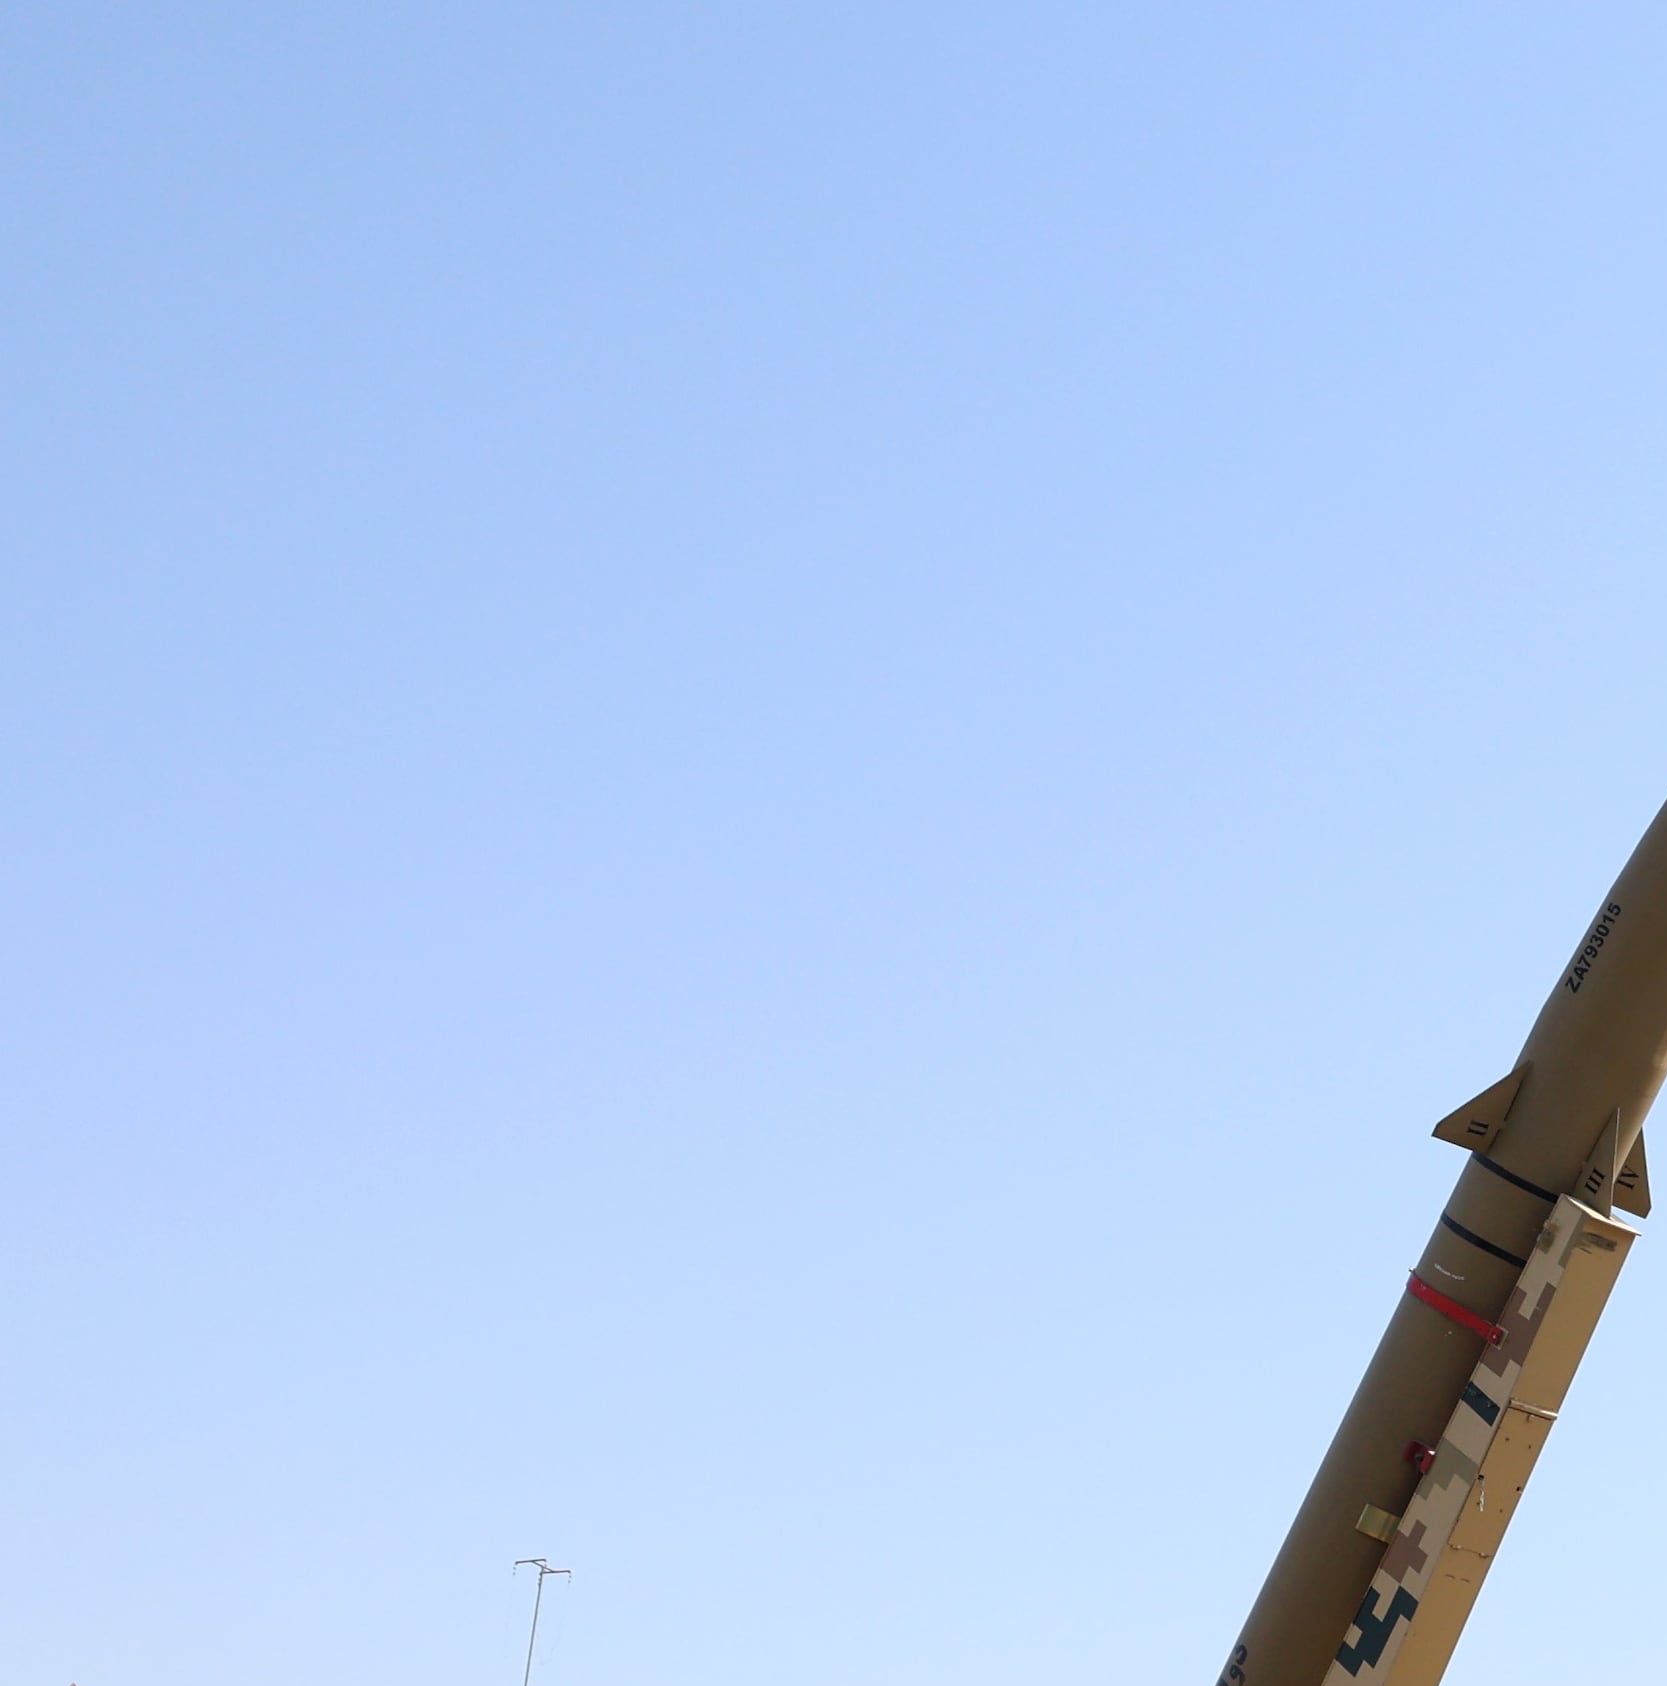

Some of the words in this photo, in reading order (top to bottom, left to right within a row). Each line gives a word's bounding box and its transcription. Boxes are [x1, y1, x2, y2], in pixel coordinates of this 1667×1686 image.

[1565, 902, 1621, 993] ZA793015
[1584, 1168, 1606, 1195] III
[1617, 1165, 1640, 1190] IV
